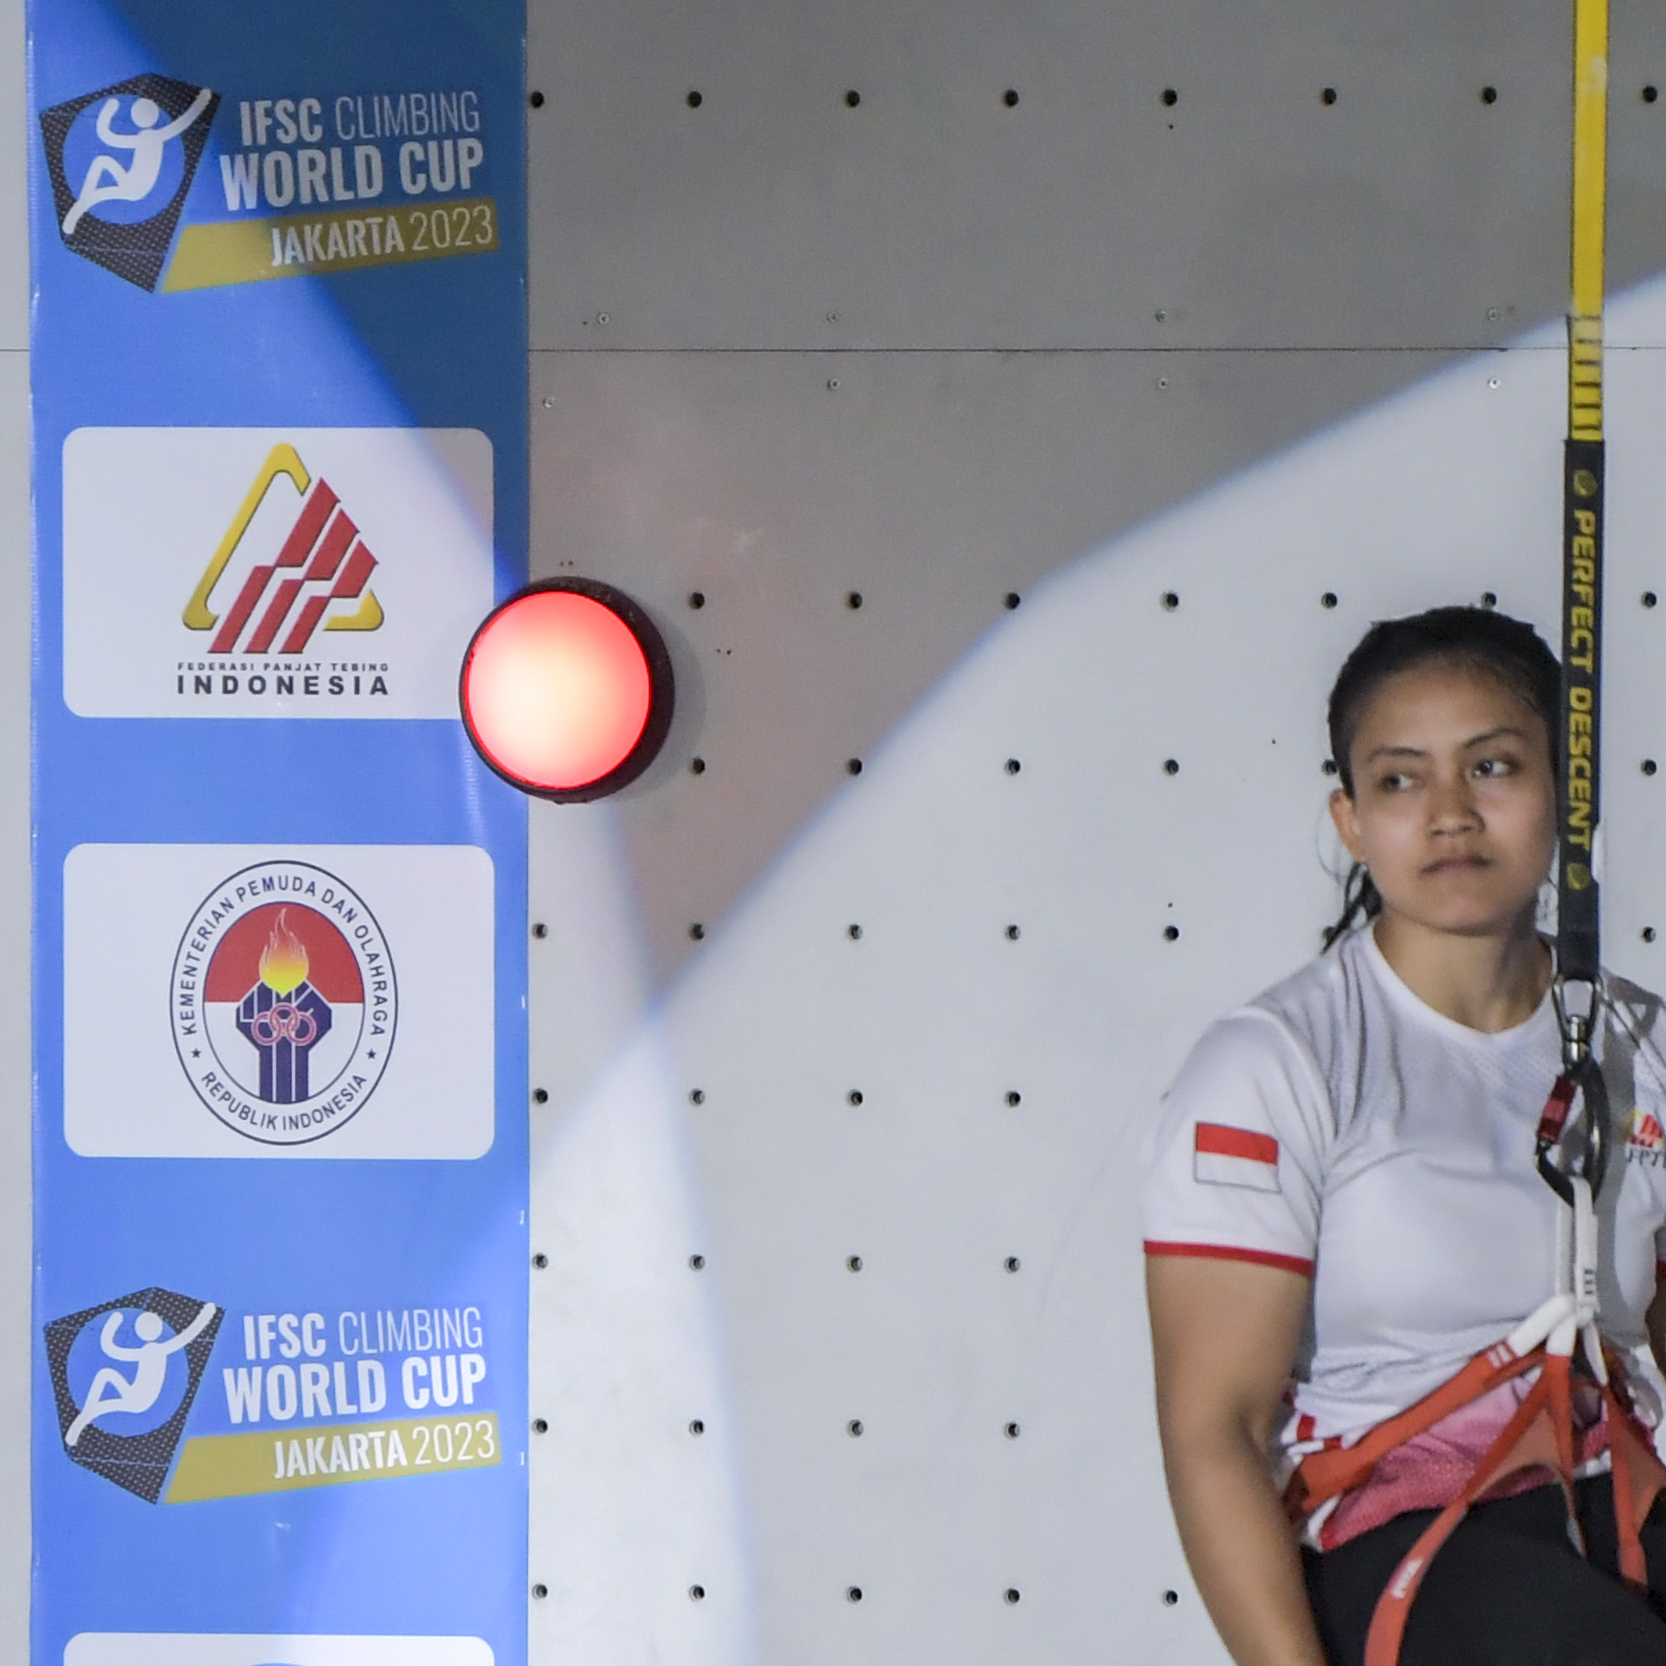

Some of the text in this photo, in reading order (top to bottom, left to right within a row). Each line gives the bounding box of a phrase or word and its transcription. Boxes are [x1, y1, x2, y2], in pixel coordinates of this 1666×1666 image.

[240, 91, 480, 146] IFSC CLIMBING
[220, 137, 484, 211] WORLD CUP
[271, 205, 493, 267] JAKARTA 2023
[177, 662, 389, 672] FEDERASI PANJAT TEBING
[177, 675, 389, 696] INDONESIA
[1567, 509, 1596, 851] PERFECT DESCENT
[180, 875, 388, 1037] KEMENTERIAN PEMUDA DAN OLAHRAGA
[201, 1071, 367, 1131] REPUBLIK INDONESIA
[243, 1307, 483, 1360] IFSC CLIMBING
[223, 1353, 486, 1424] WORLD CUP
[274, 1420, 495, 1479] JAKARTA 2023
